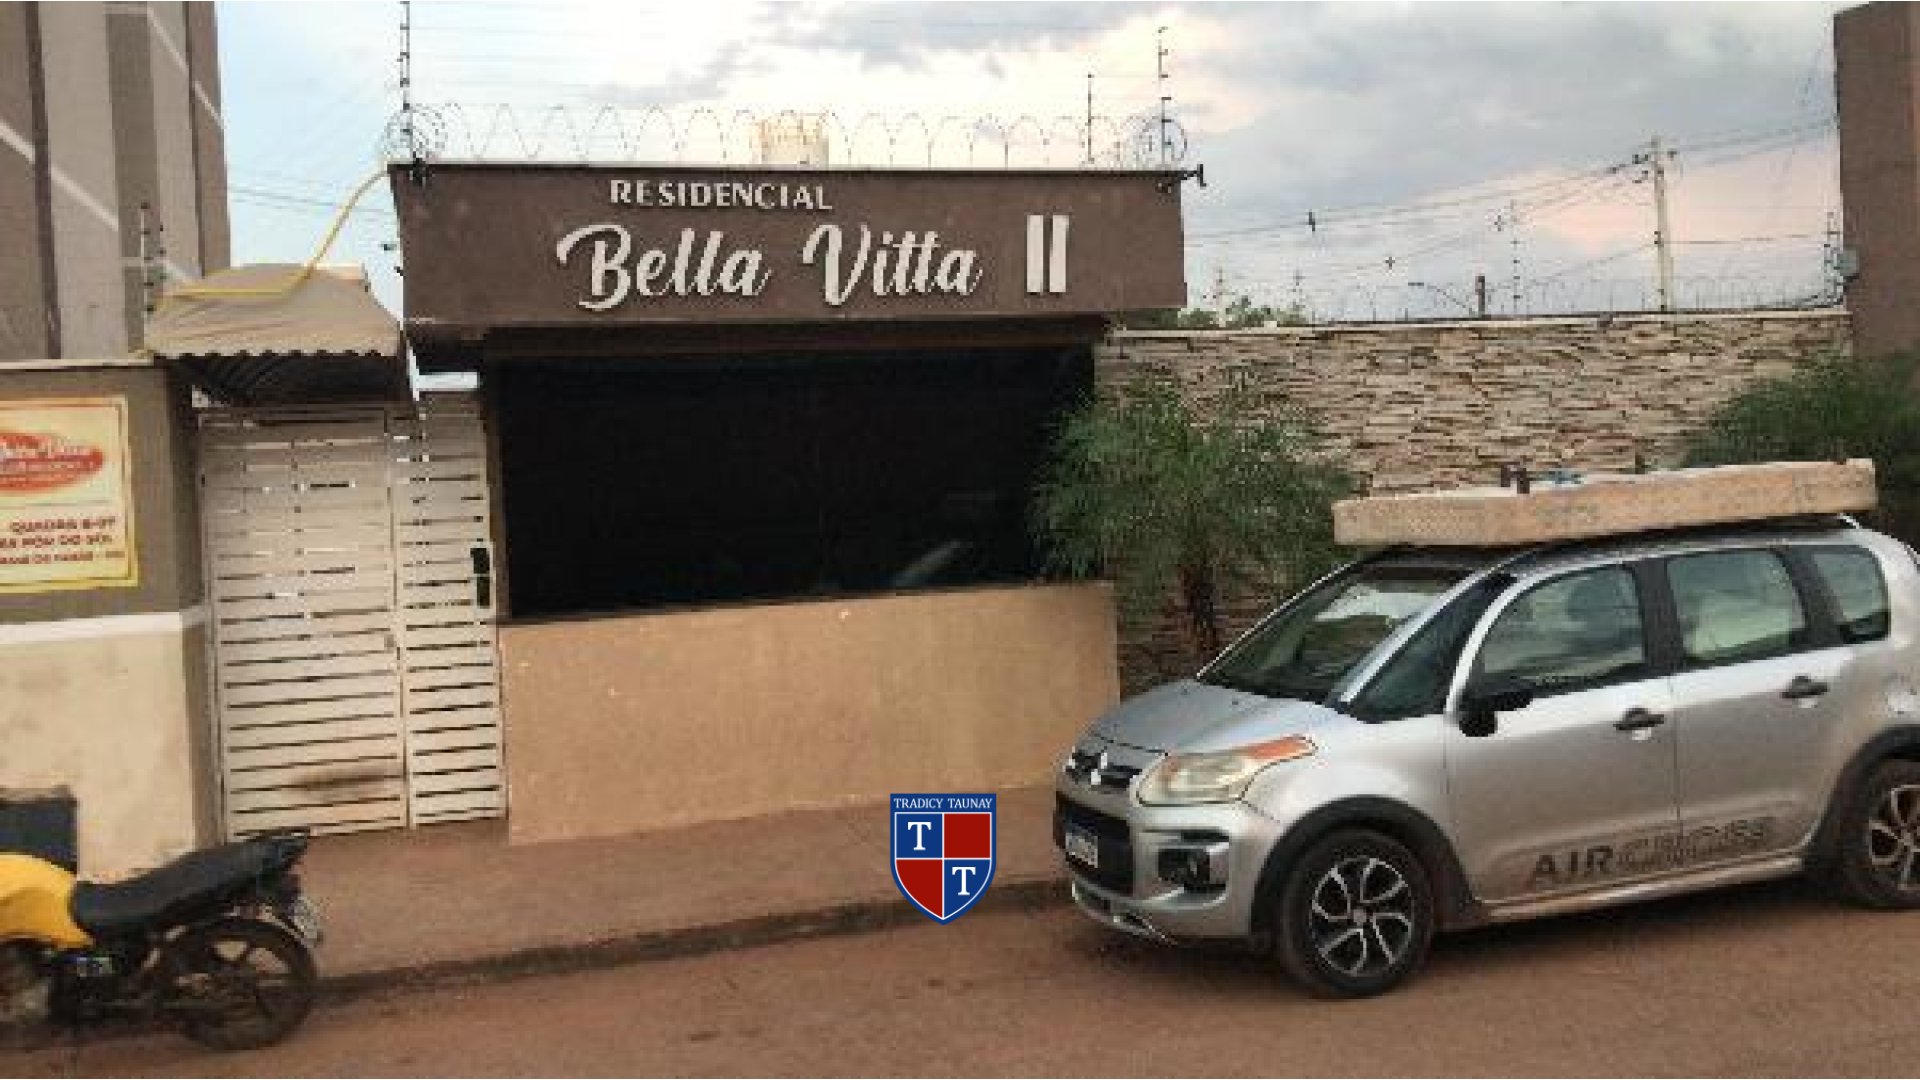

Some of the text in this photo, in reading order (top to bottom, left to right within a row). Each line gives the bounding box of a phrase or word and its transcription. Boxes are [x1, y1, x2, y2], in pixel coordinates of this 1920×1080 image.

[608, 179, 833, 211] RESIDENCIAL
[556, 214, 1070, 311] Bella Vitta II
